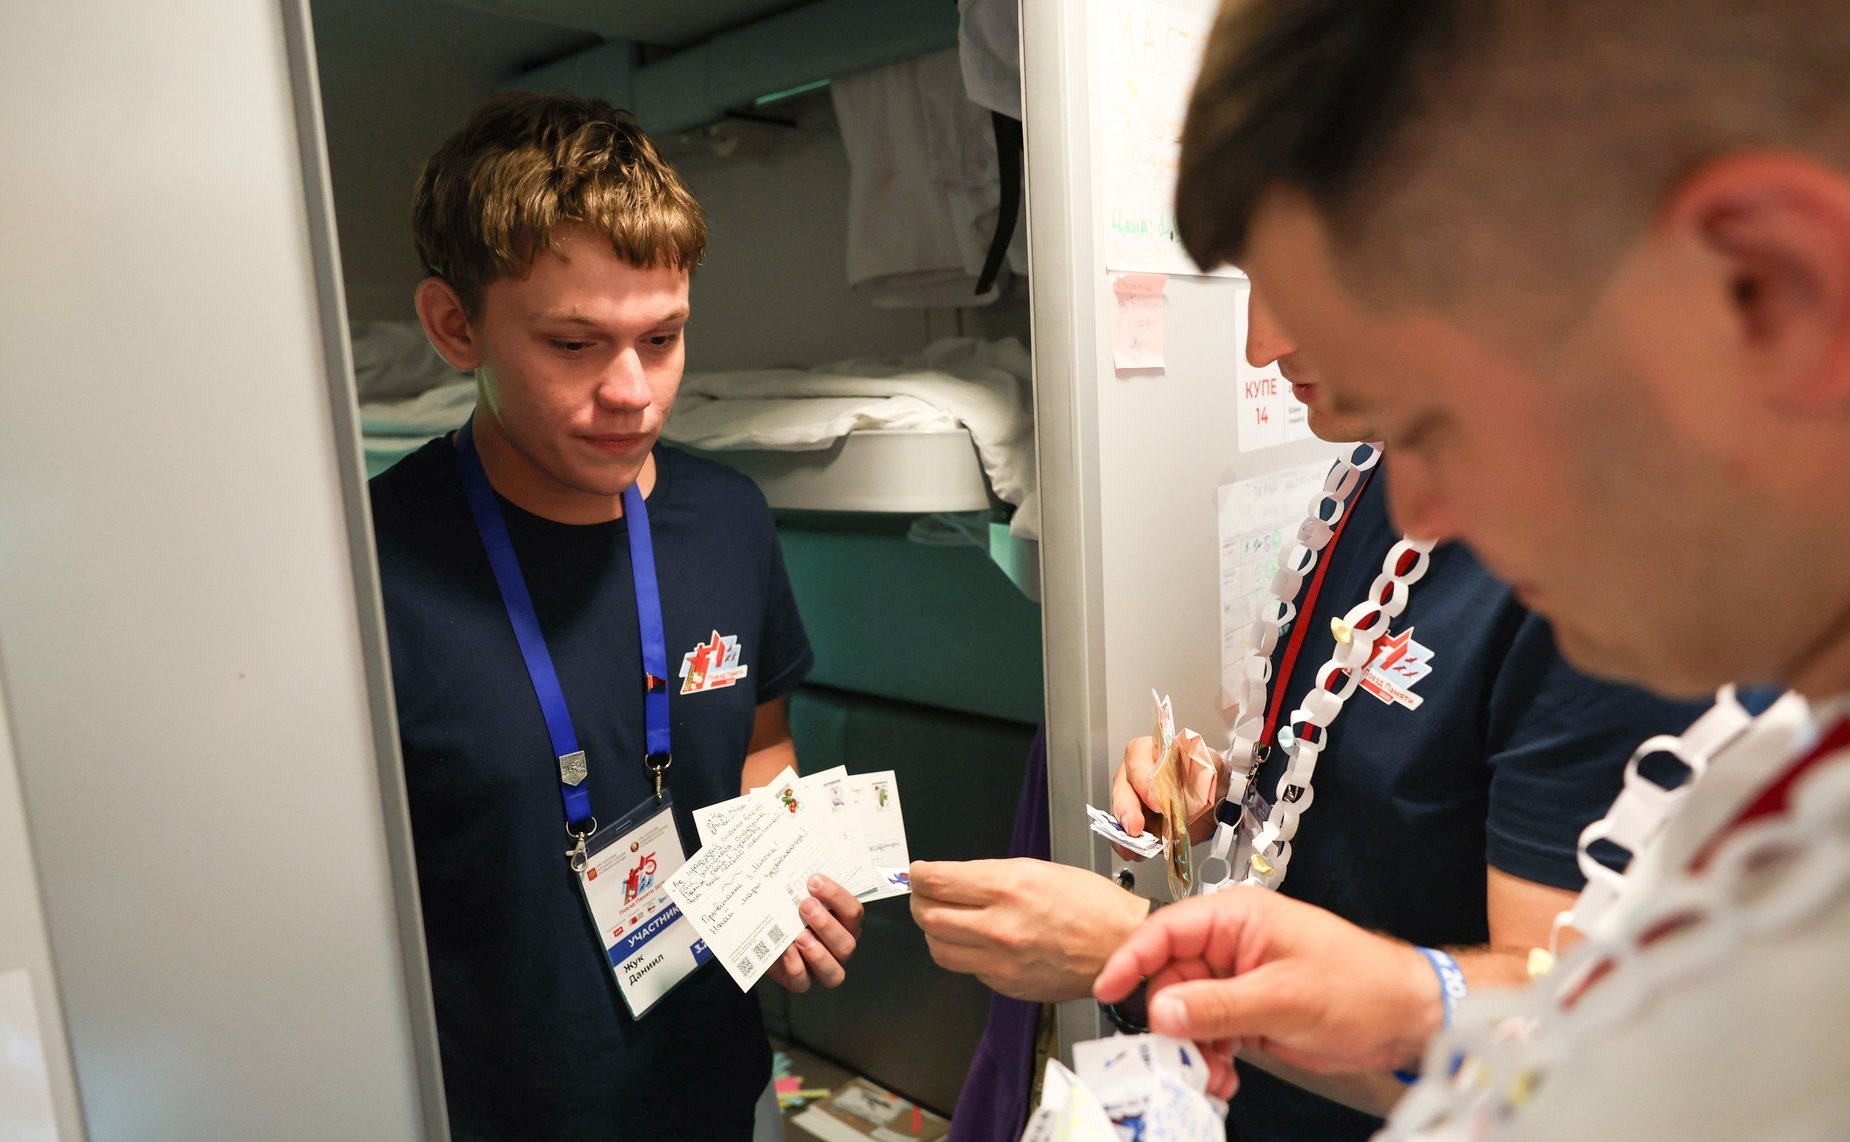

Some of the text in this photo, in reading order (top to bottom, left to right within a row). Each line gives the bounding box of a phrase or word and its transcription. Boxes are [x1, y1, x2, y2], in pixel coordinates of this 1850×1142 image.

[1245, 378, 1277, 399] КУПЕ
[1255, 407, 1269, 425] 14
[1363, 669, 1384, 687] Поезд
[1384, 681, 1414, 705] Памяти
[619, 900, 636, 915] Поезд
[635, 887, 655, 905] Памяти
[628, 905, 680, 947] УЧАСТНИК
[623, 955, 644, 974] Жук
[629, 953, 664, 986] Даниил
